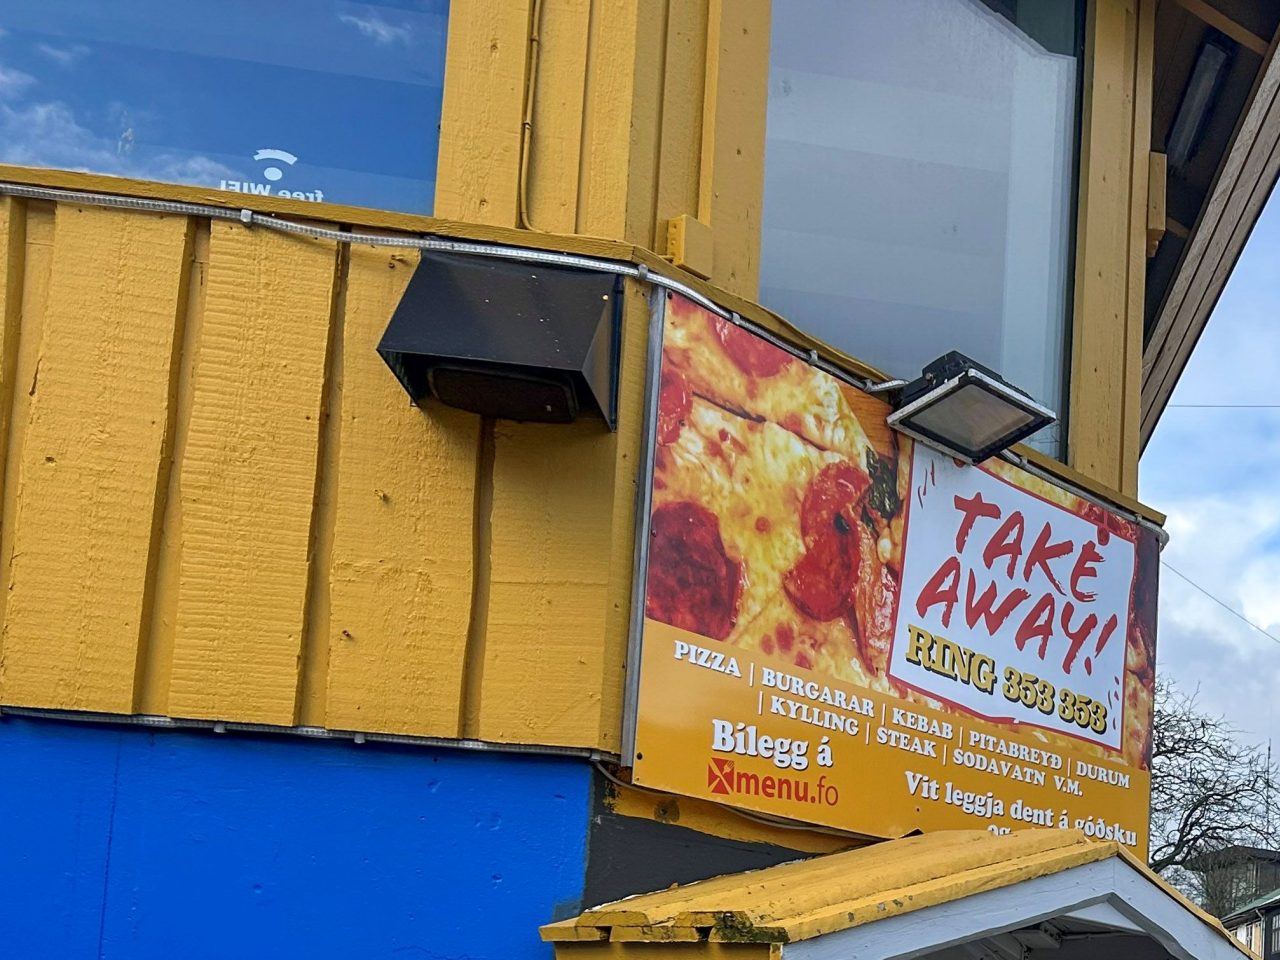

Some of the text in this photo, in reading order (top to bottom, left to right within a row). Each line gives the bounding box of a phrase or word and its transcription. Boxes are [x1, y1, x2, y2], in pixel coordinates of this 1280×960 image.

[954, 492, 1105, 603] TAKE
[916, 556, 1118, 676] AWAY!
[674, 640, 1131, 788] PIZZA BURGARAR KEBAB PITABREYÐ DURUM
[905, 624, 1108, 734] RING 353 353
[711, 718, 834, 771] Bílegg á
[736, 770, 839, 806] menu.fo
[770, 695, 1083, 797] KYLLING STEAK SODAVATN V.M.
[904, 770, 939, 802] Vit
[944, 782, 1004, 818] leggja
[1009, 799, 1055, 828] dent
[1058, 809, 1069, 829] á
